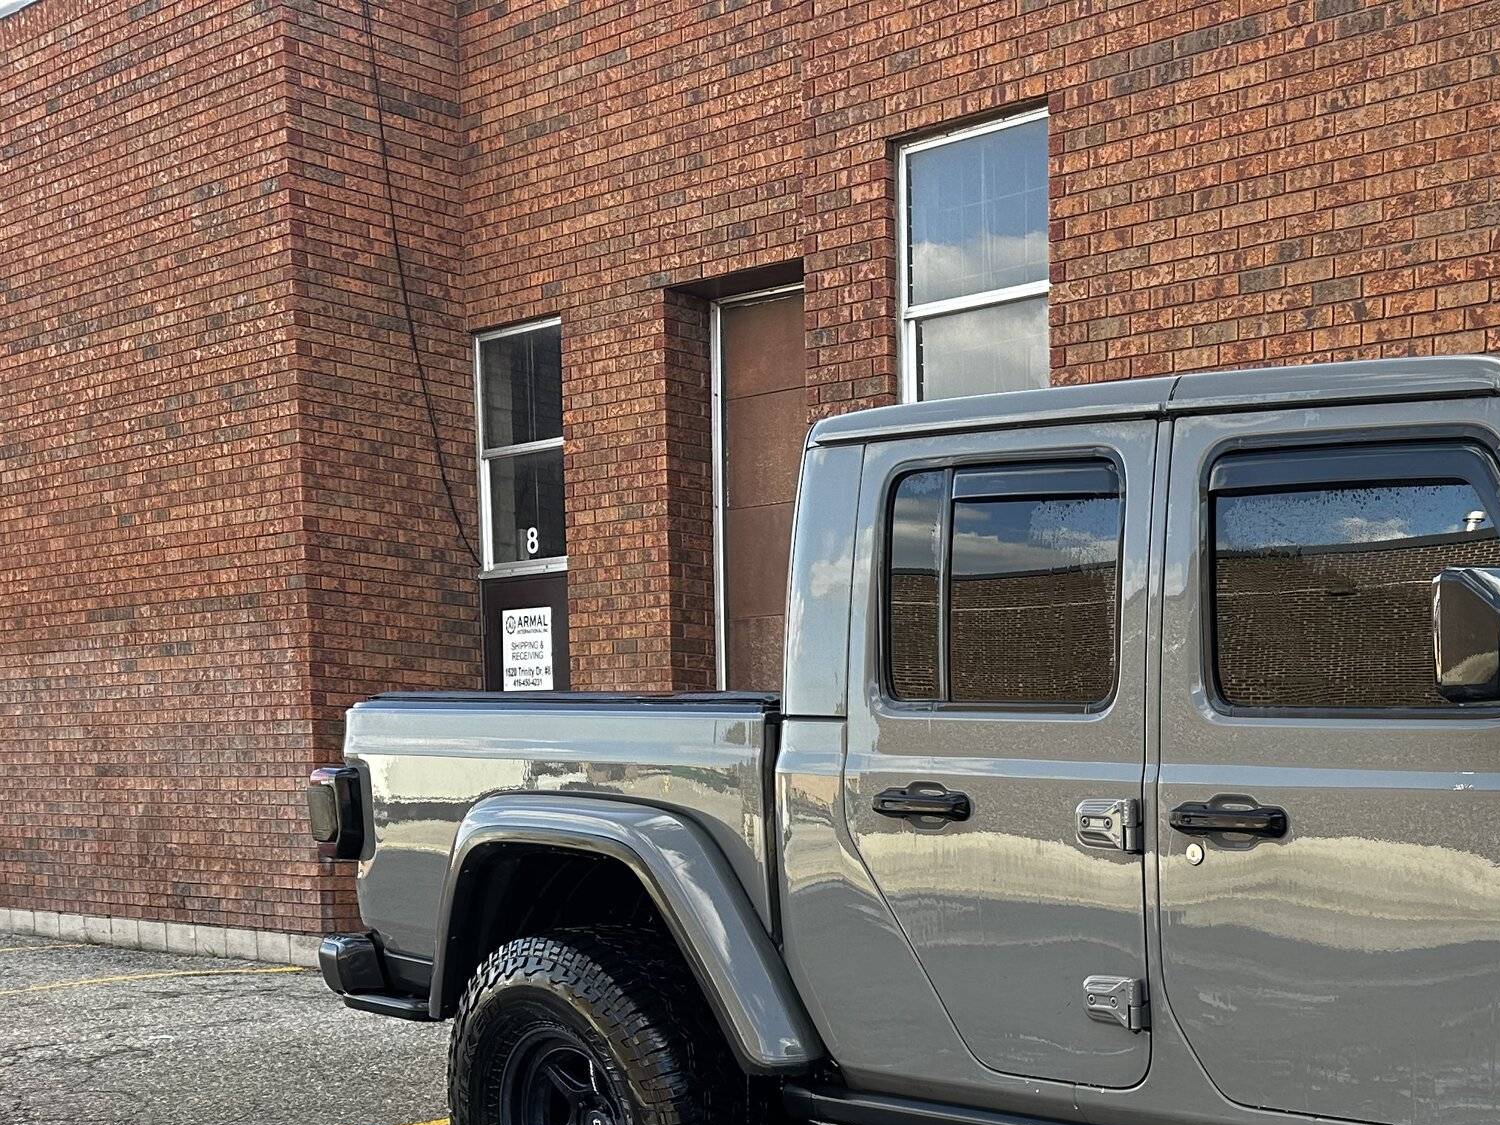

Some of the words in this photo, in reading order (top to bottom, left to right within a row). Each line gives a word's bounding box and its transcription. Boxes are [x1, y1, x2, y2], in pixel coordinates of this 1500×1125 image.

[527, 527, 538, 554] 8
[517, 614, 548, 628] ARMAL
[511, 641, 539, 650] SHIPPING
[540, 640, 544, 649] &
[511, 651, 544, 661] RECEIVING
